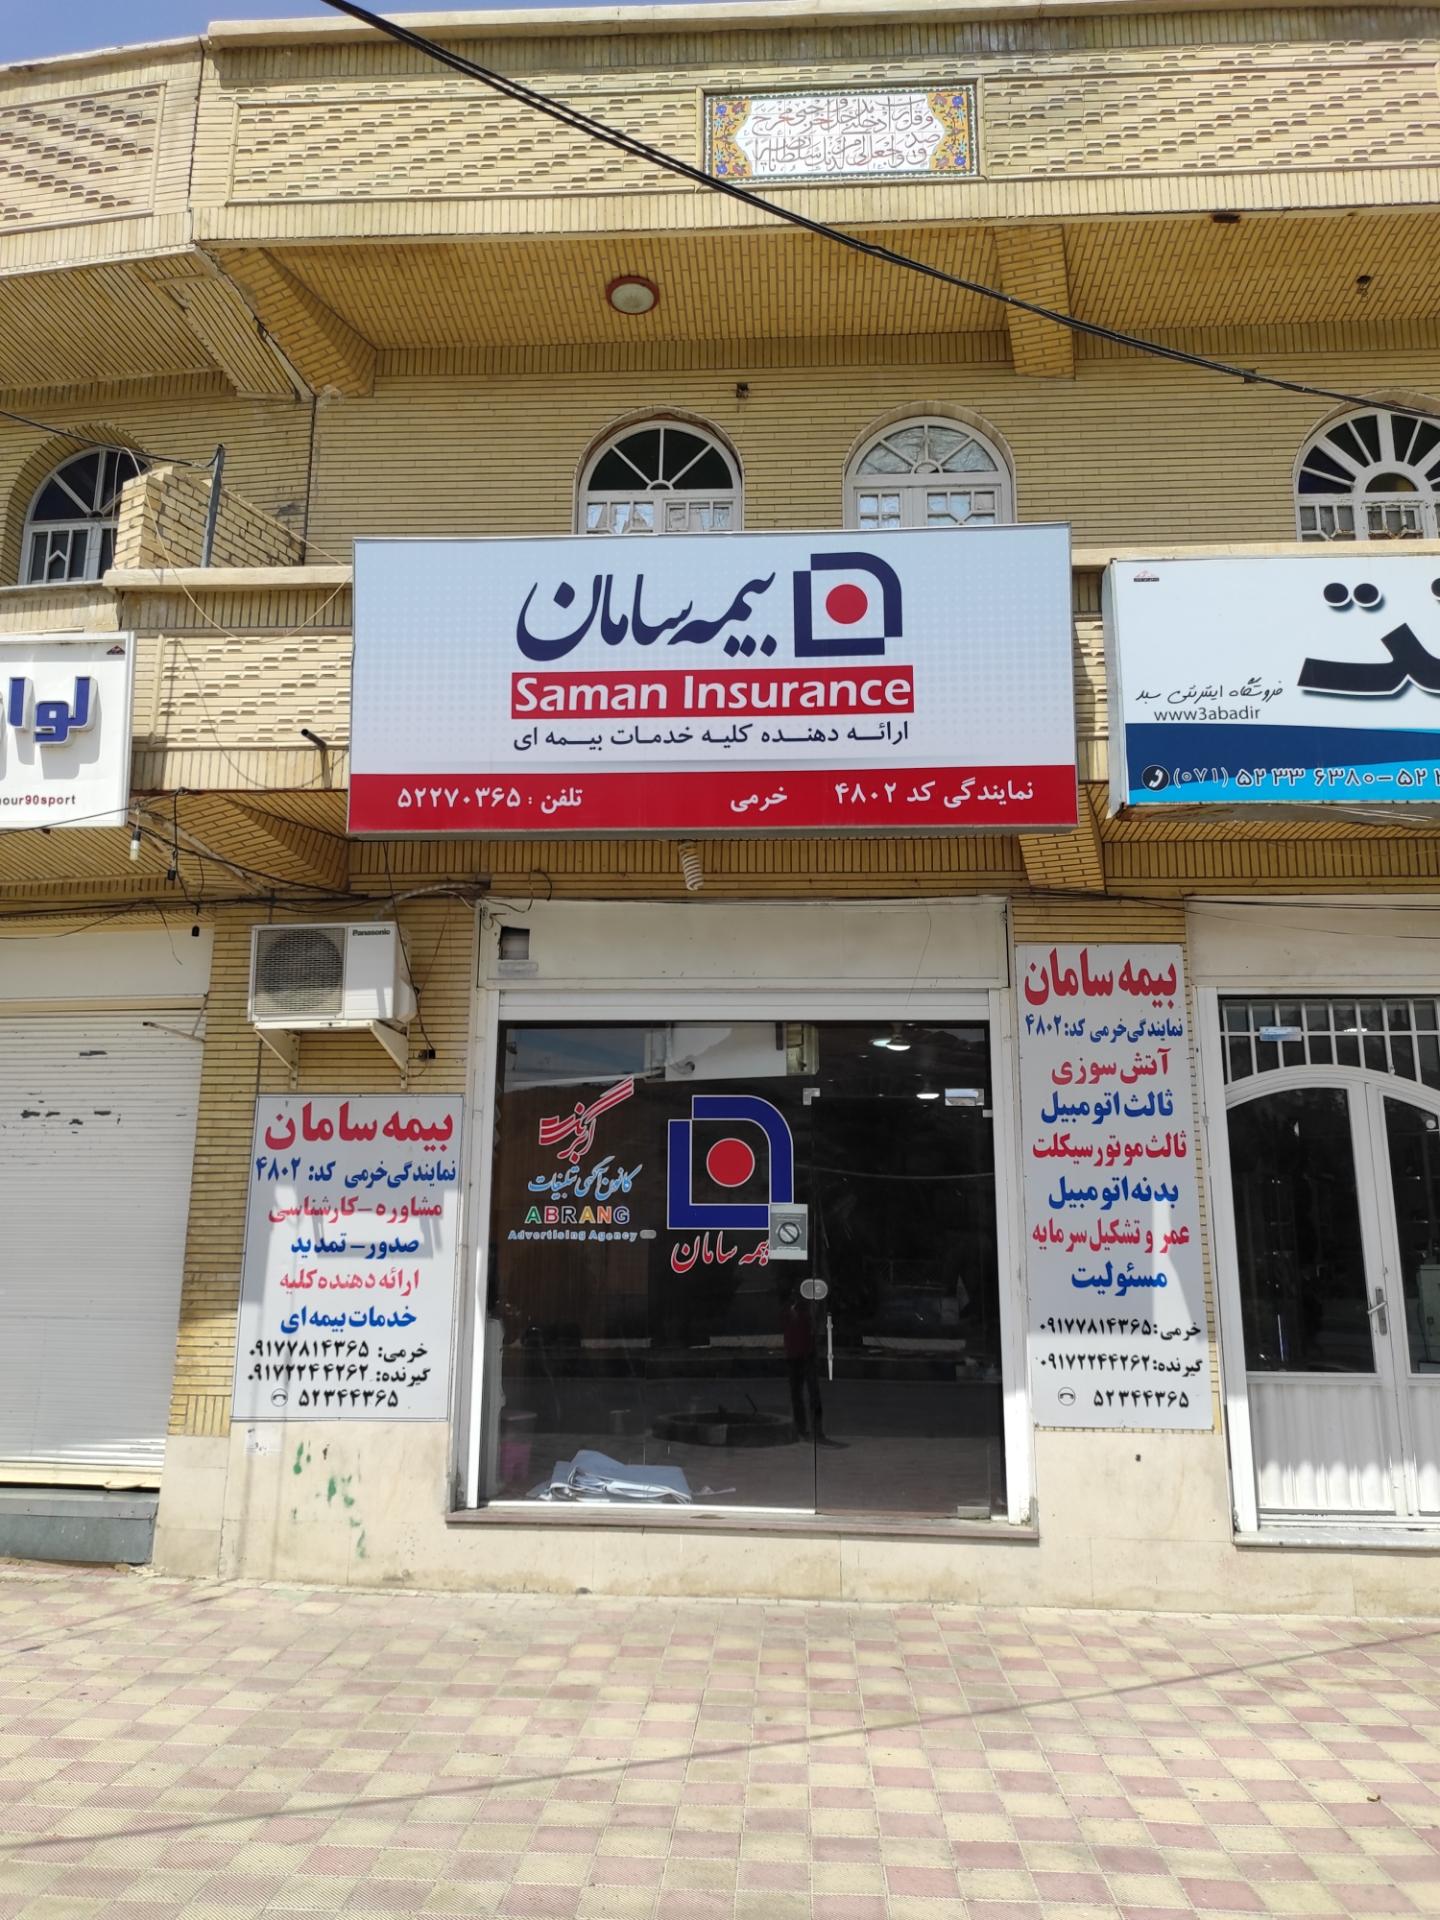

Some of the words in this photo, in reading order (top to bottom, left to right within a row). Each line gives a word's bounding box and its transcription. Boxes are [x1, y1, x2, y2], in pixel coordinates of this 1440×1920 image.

[516, 573, 693, 662] سامان
[667, 571, 777, 658] بیمه
[515, 677, 667, 711] Saman
[684, 675, 911, 709] Insurance
[1167, 684, 1223, 704] اینترنتی
[1229, 676, 1283, 703] فروشگاه
[7, 676, 92, 744] لوا
[513, 727, 537, 751] ای
[545, 730, 602, 751] بیمه
[611, 725, 693, 745] خدمات
[701, 724, 752, 748] کلیه
[761, 726, 838, 744] دهنده
[847, 722, 909, 746] ارائه
[0, 793, 76, 808] our90sport
[397, 786, 521, 808] ۵۲۲۷۰۳۶۵
[730, 786, 788, 812] خرمی
[835, 781, 897, 804] ۴۸۰۲
[906, 780, 936, 802] کد
[943, 777, 1034, 808] نمایندگی
[1024, 947, 1114, 1006] سامان
[1118, 959, 1177, 1009] بیمه
[1025, 1013, 1062, 1037] ۴۸۰۲
[1090, 1018, 1127, 1043] خرمی
[1127, 1017, 1183, 1042] نمایندگی
[1051, 1057, 1117, 1085] سوزی
[1120, 1048, 1171, 1084] آتش
[1041, 1091, 1120, 1125] اتومبیل
[1124, 1089, 1173, 1117] ثالث
[264, 1101, 378, 1151] سامان
[382, 1110, 454, 1152] بیمه
[1032, 1132, 1144, 1167] موتورسیکلت
[1145, 1130, 1187, 1158] ثالث
[255, 1157, 301, 1182] ۴۸۰۲
[344, 1161, 388, 1189] خرمی
[387, 1160, 456, 1189] نمایندگی
[528, 1165, 580, 1200] تبلیغات
[595, 1163, 643, 1200] کانون
[1048, 1176, 1129, 1210] اتومبیل
[1131, 1176, 1179, 1208] بدنه
[524, 1206, 630, 1224] ABRANG
[290, 1233, 346, 1259] تمدید
[508, 1230, 587, 1242] Advertising
[588, 1230, 638, 1243] Agency
[1032, 1217, 1088, 1252] سرمایه
[1089, 1217, 1141, 1252] تشکیل
[1144, 1229, 1154, 1254] و
[1159, 1225, 1190, 1254] عمر
[671, 1230, 738, 1274] سامان
[279, 1268, 318, 1295] کلیه
[318, 1272, 376, 1289] دهنده
[379, 1266, 420, 1297] ارائه
[1071, 1260, 1168, 1297] مسئولیت
[280, 1304, 307, 1333] ای
[309, 1310, 346, 1333] بیمه
[349, 1305, 417, 1328] خدمات
[1040, 1317, 1151, 1337] ۰۹۱۷۷۸۱۴۳۶۵
[249, 1339, 369, 1358] ۰۹۱۷۷۸۱۴۳۶۵
[247, 1363, 369, 1382] ۰۹۱۷۲۲۴۴۲۶۲
[1041, 1353, 1151, 1373] ۰۹۱۷۲۲۴۴۲۶۲
[298, 1388, 399, 1408] ۵۲۳۴۴۳۶۵
[1093, 1389, 1190, 1408] ۵۲۳۴۴۳۶۵
